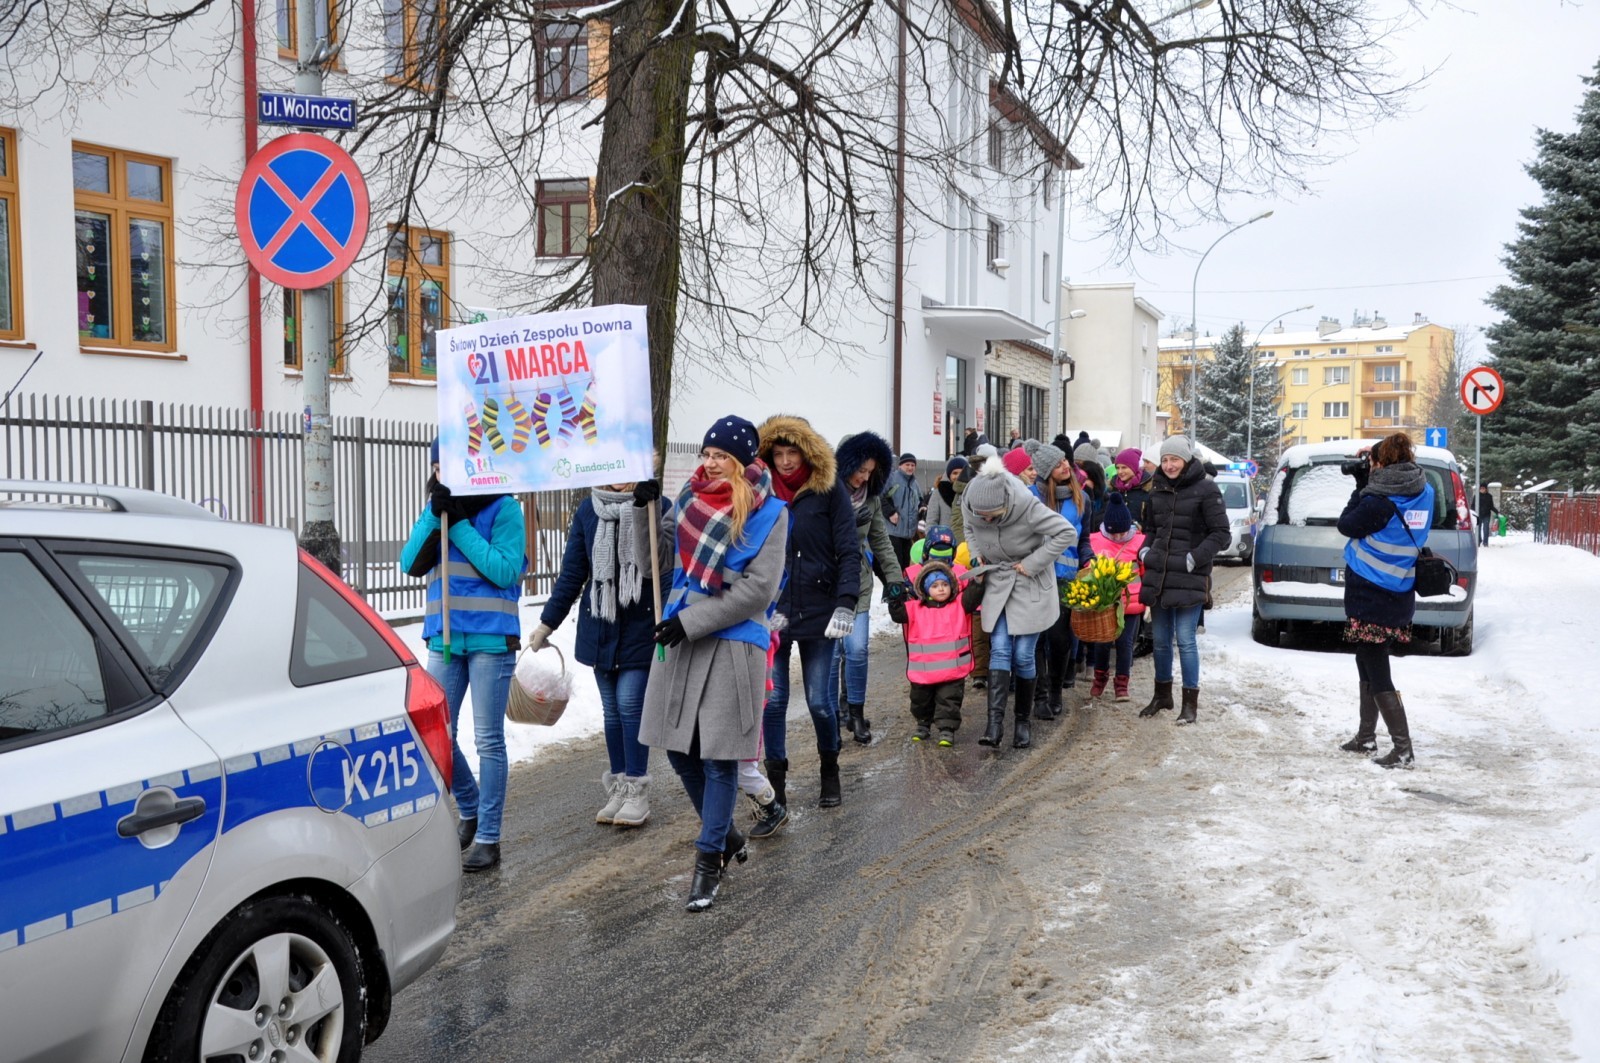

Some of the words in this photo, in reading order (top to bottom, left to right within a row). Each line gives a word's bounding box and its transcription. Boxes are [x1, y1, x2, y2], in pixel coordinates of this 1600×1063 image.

[479, 330, 520, 348] Dzień
[523, 324, 579, 342] Zespołu
[583, 319, 633, 335] Downa
[474, 351, 500, 385] 21
[504, 340, 590, 381] MARCA
[575, 461, 616, 473] Fundacja
[616, 459, 626, 469] 21
